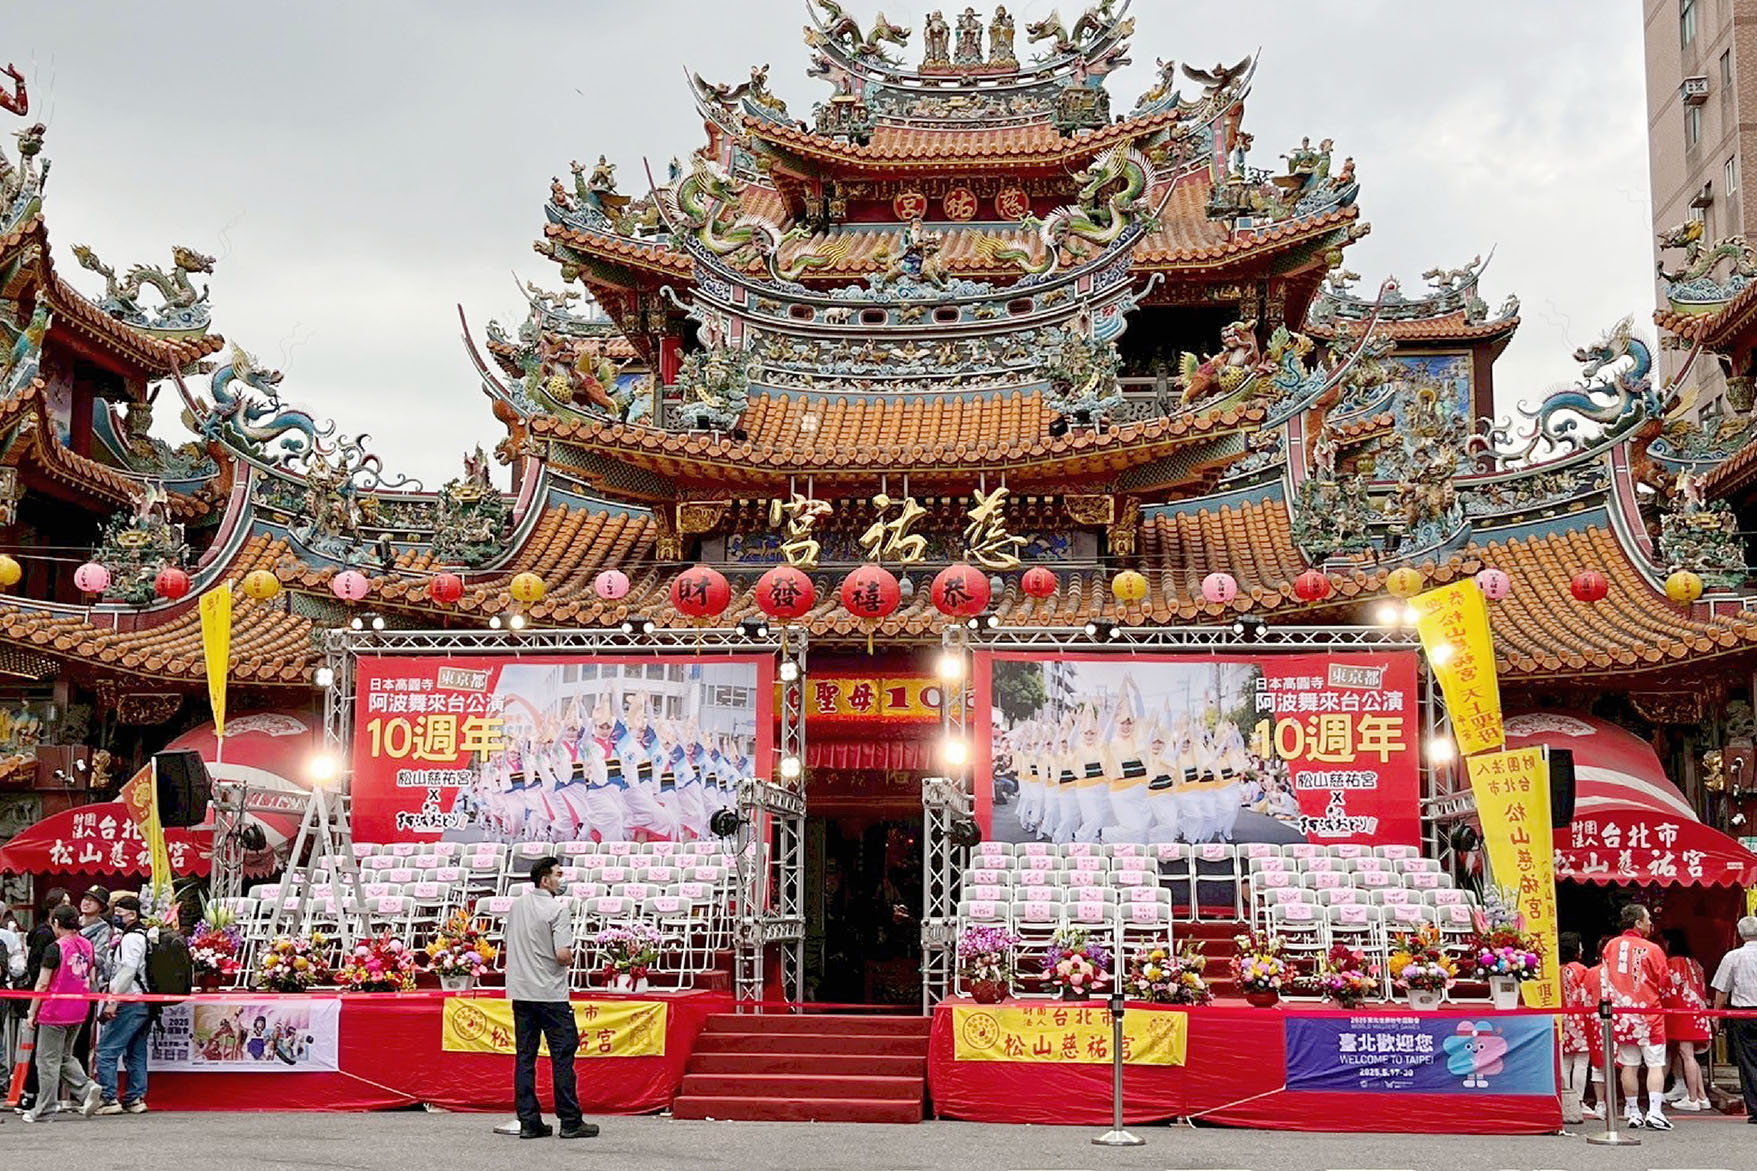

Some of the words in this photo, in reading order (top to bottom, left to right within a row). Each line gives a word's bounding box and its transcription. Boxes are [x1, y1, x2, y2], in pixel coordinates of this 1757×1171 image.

[441, 671, 486, 690] 東京都
[1332, 669, 1380, 686] 東京都
[369, 692, 505, 713] 阿波舞來台公演
[1256, 691, 1403, 713] 阿波舞來台公演
[367, 715, 505, 762] 10週年
[1253, 714, 1407, 763] 10週年
[397, 770, 472, 787] 松山慈祐宮
[1297, 772, 1377, 788] 松山慈祐宮
[1601, 822, 1680, 848] 台北市
[1553, 848, 1707, 878] 松山慈祐宮
[1339, 1033, 1433, 1053] 臺北歡迎您
[1339, 1055, 1389, 1065] WELCOME
[1391, 1055, 1402, 1065] TO
[1404, 1055, 1435, 1065] TAIPEI
